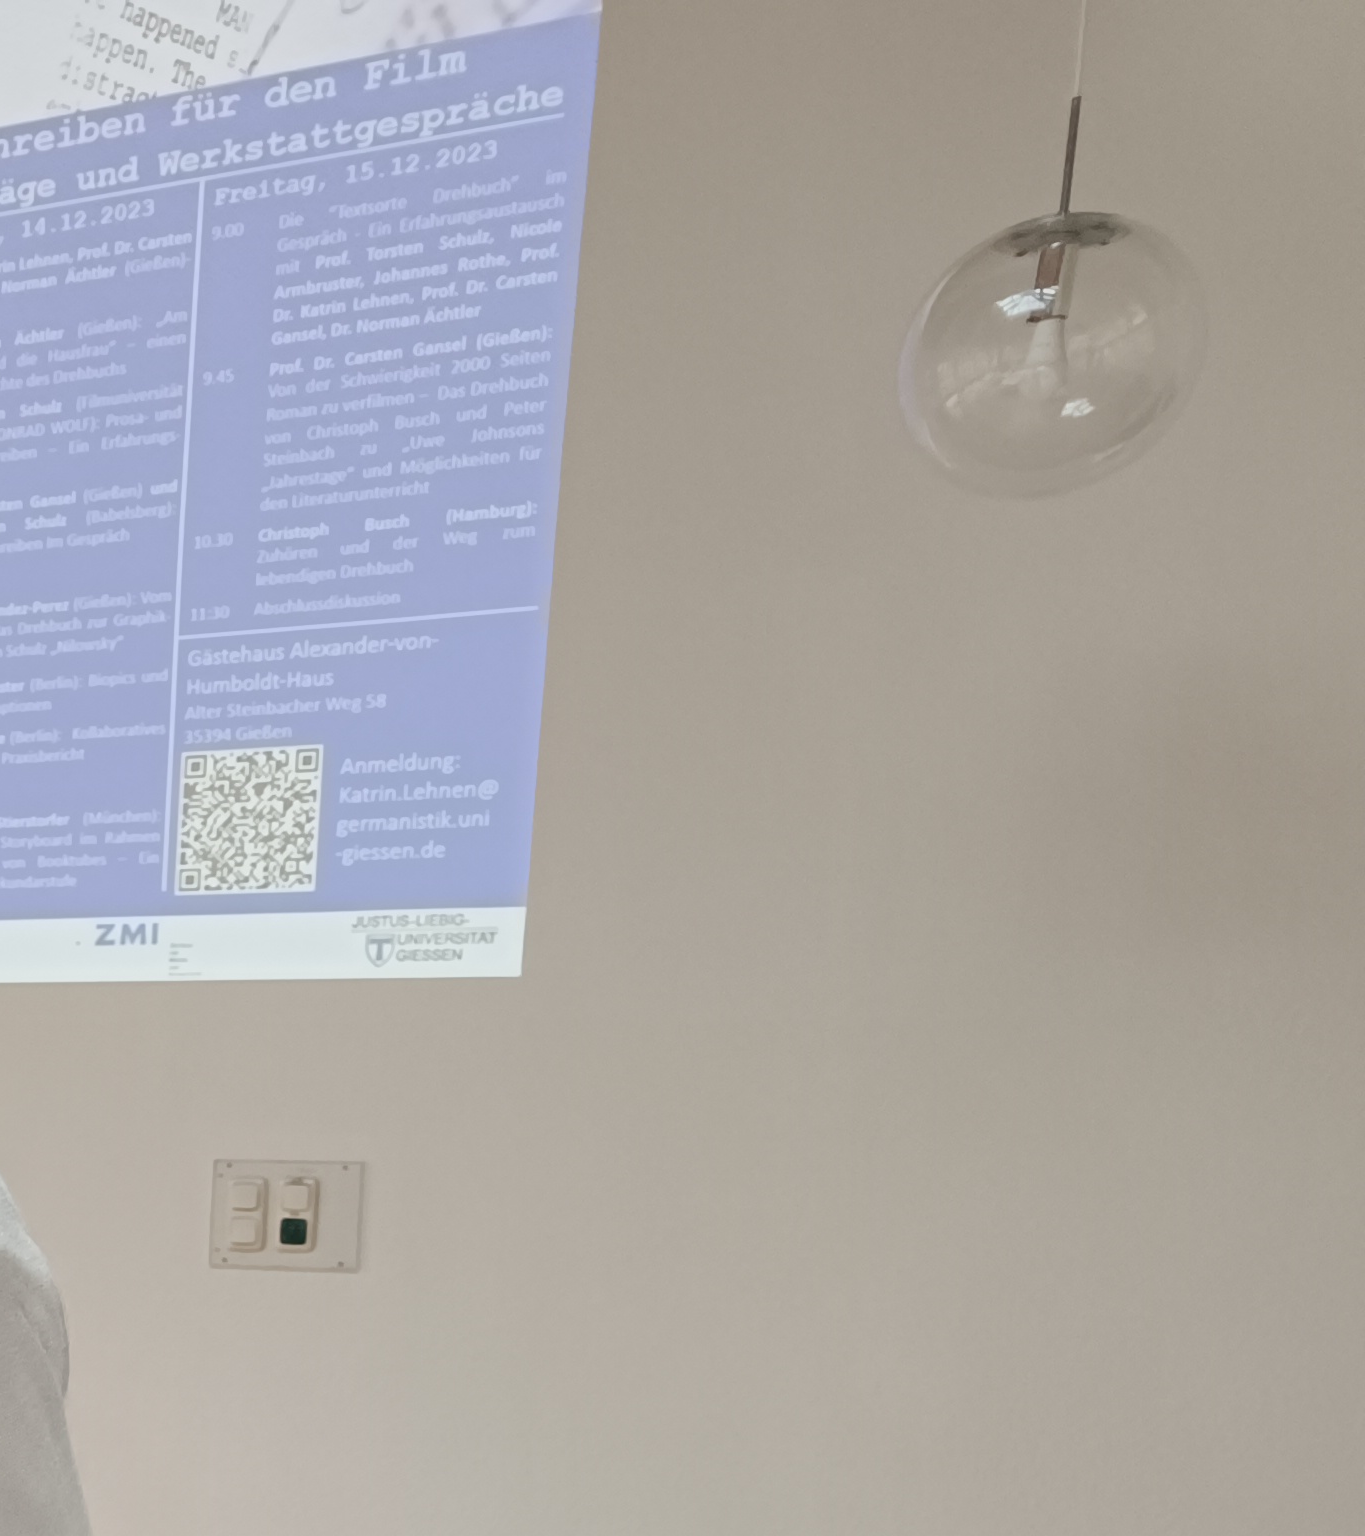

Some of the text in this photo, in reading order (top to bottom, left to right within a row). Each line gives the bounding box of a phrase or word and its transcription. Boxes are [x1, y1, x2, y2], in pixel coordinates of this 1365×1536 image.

[170, 91, 240, 127] für
[263, 75, 336, 109] den
[363, 47, 466, 91] Film
[76, 154, 139, 191] und
[158, 85, 563, 175] Werkstattgespräche
[214, 138, 497, 206] Freitag, 15.12.2023
[21, 197, 154, 238] 14.12.2023
[187, 634, 438, 667] Gästehaus Alexander-von-
[186, 670, 334, 695] Humboldt-Haus
[339, 752, 460, 775] Anmeldung:
[338, 778, 499, 804] Katrin.Lehnen@
[94, 922, 160, 946] ZMI
